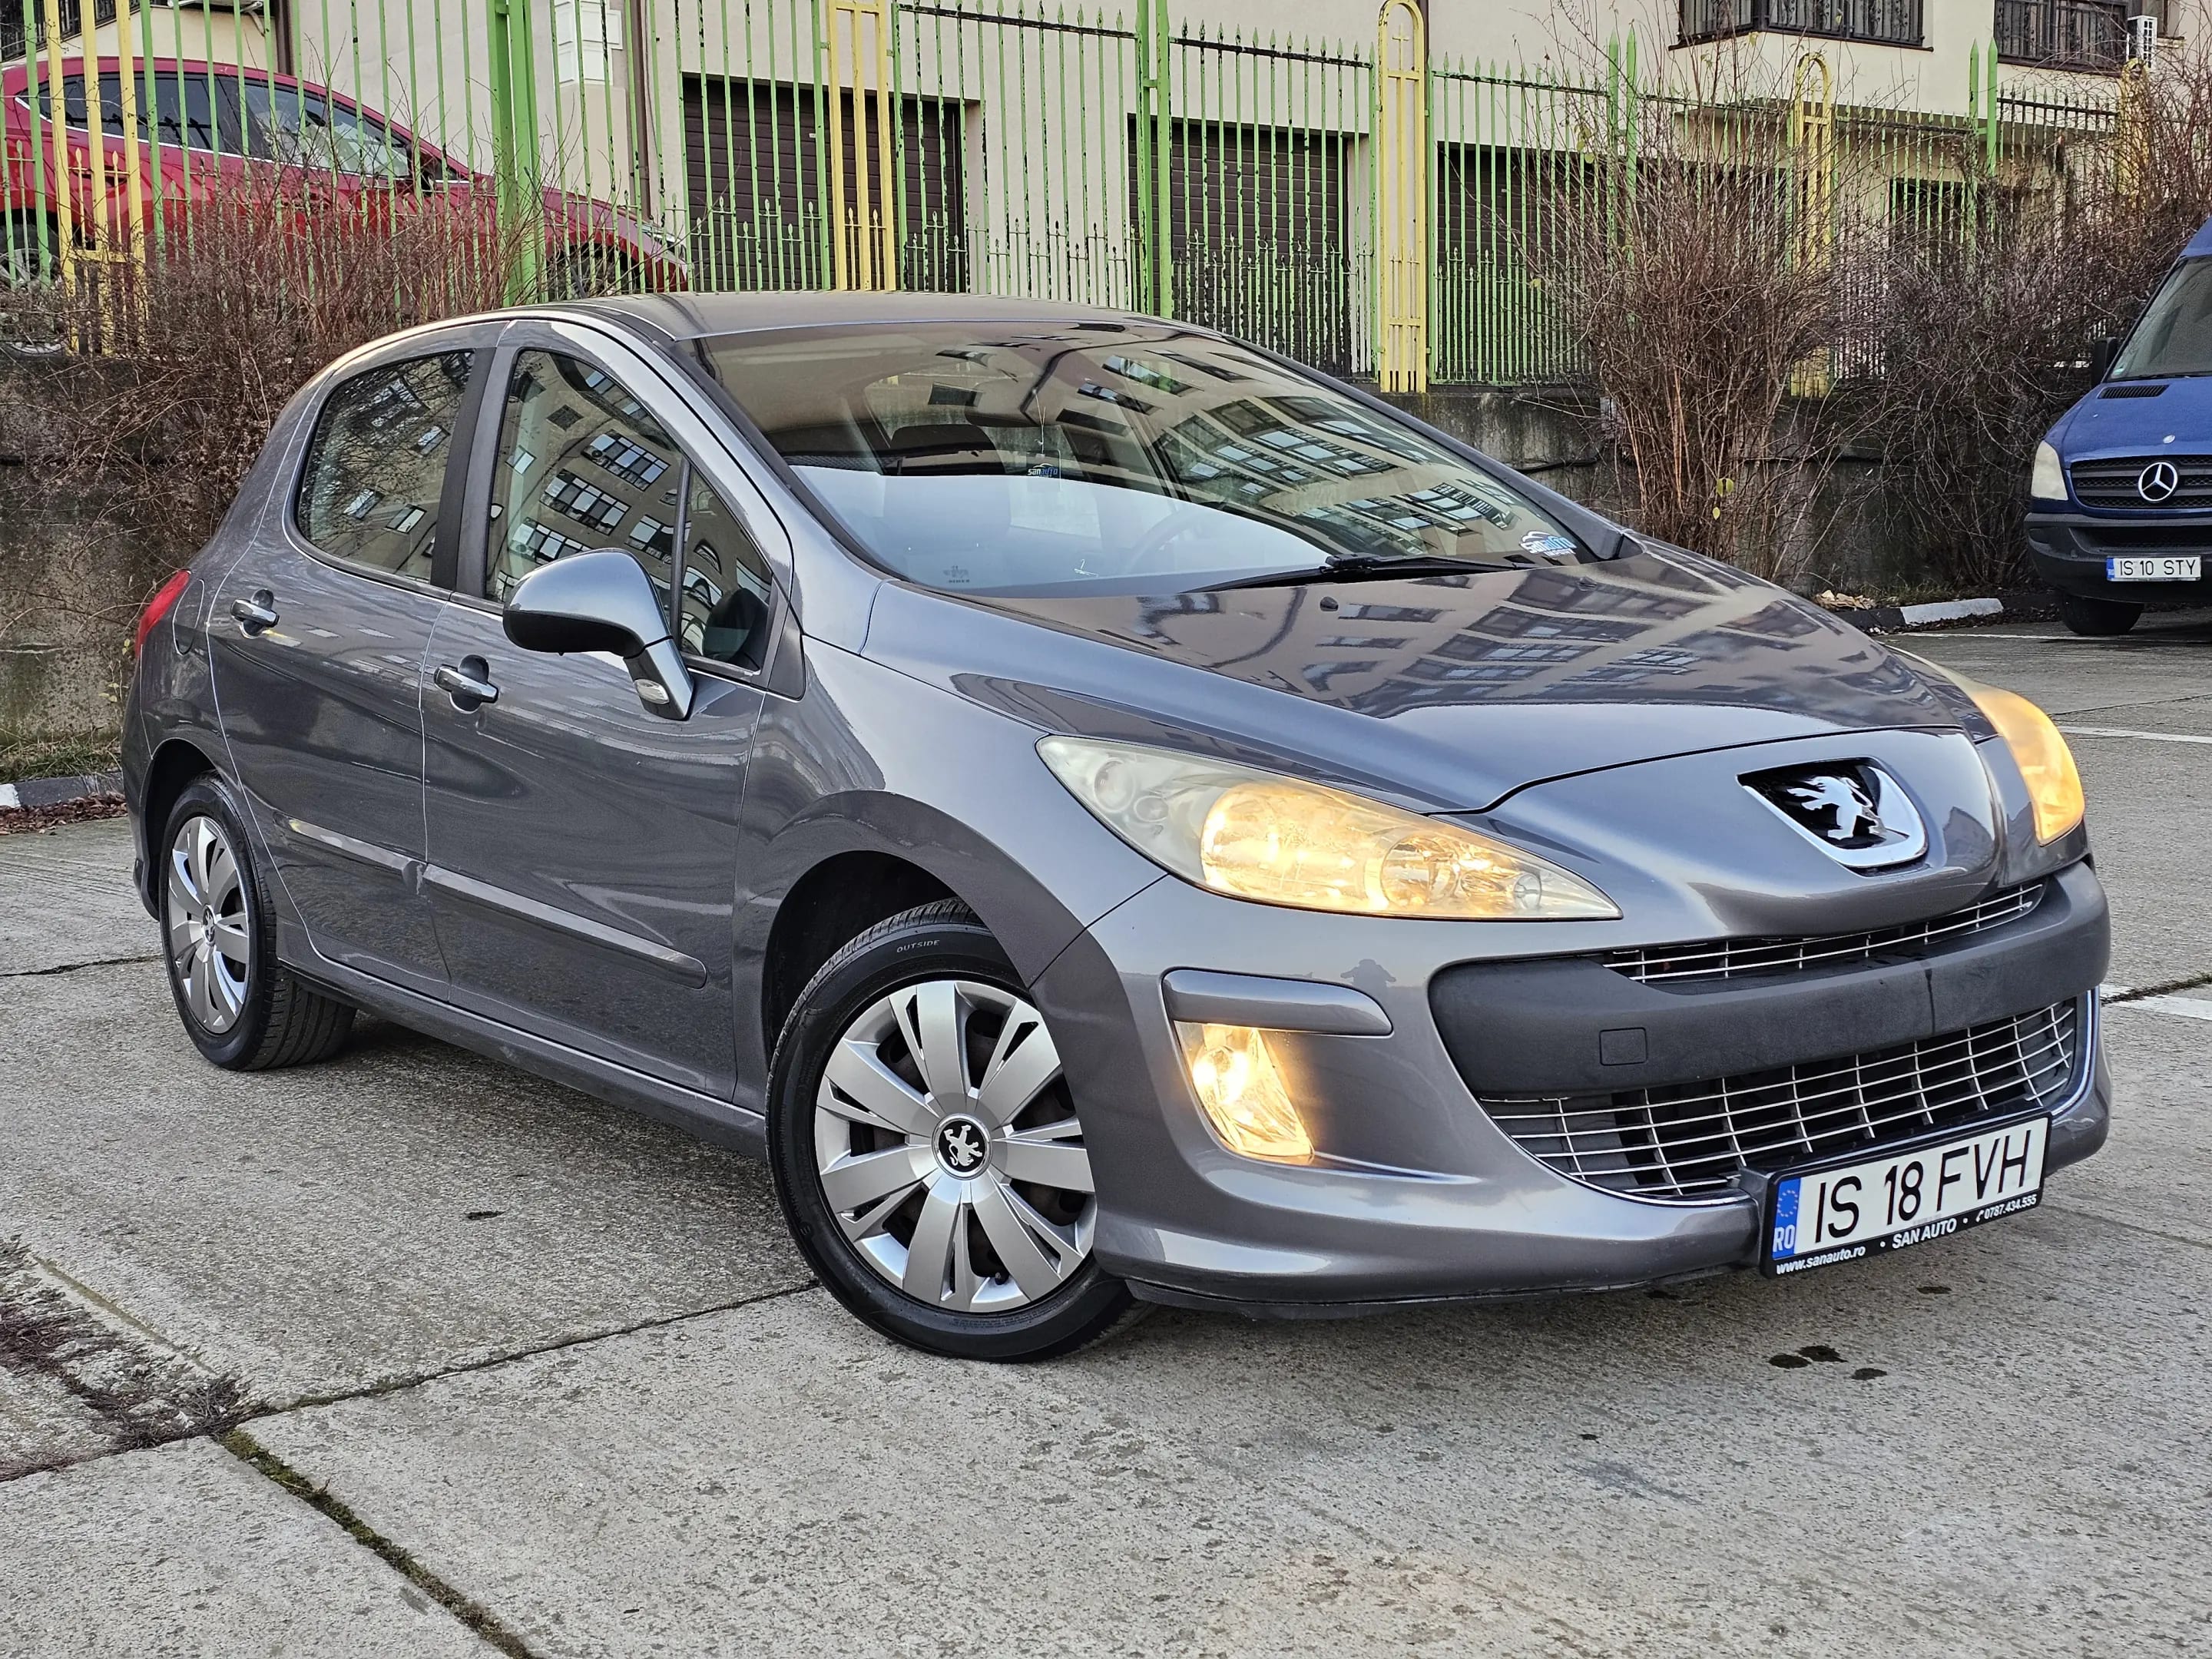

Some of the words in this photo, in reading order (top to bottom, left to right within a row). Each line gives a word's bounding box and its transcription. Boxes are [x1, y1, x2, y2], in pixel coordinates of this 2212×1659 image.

[2120, 560, 2134, 575] IS
[2140, 561, 2154, 575] 10
[2164, 560, 2196, 575] STY
[896, 939, 940, 953] OUTSIDE
[1815, 1176, 1862, 1243] IS
[1884, 1161, 1923, 1226] 18
[1937, 1130, 2032, 1212] FVH
[1773, 1224, 1796, 1253] RO
[1776, 1246, 1866, 1275] www.sanauto.ro
[1892, 1227, 1920, 1249] SAN
[1920, 1217, 1958, 1241] AUTO
[1984, 1194, 2038, 1220] 0787.434.555
